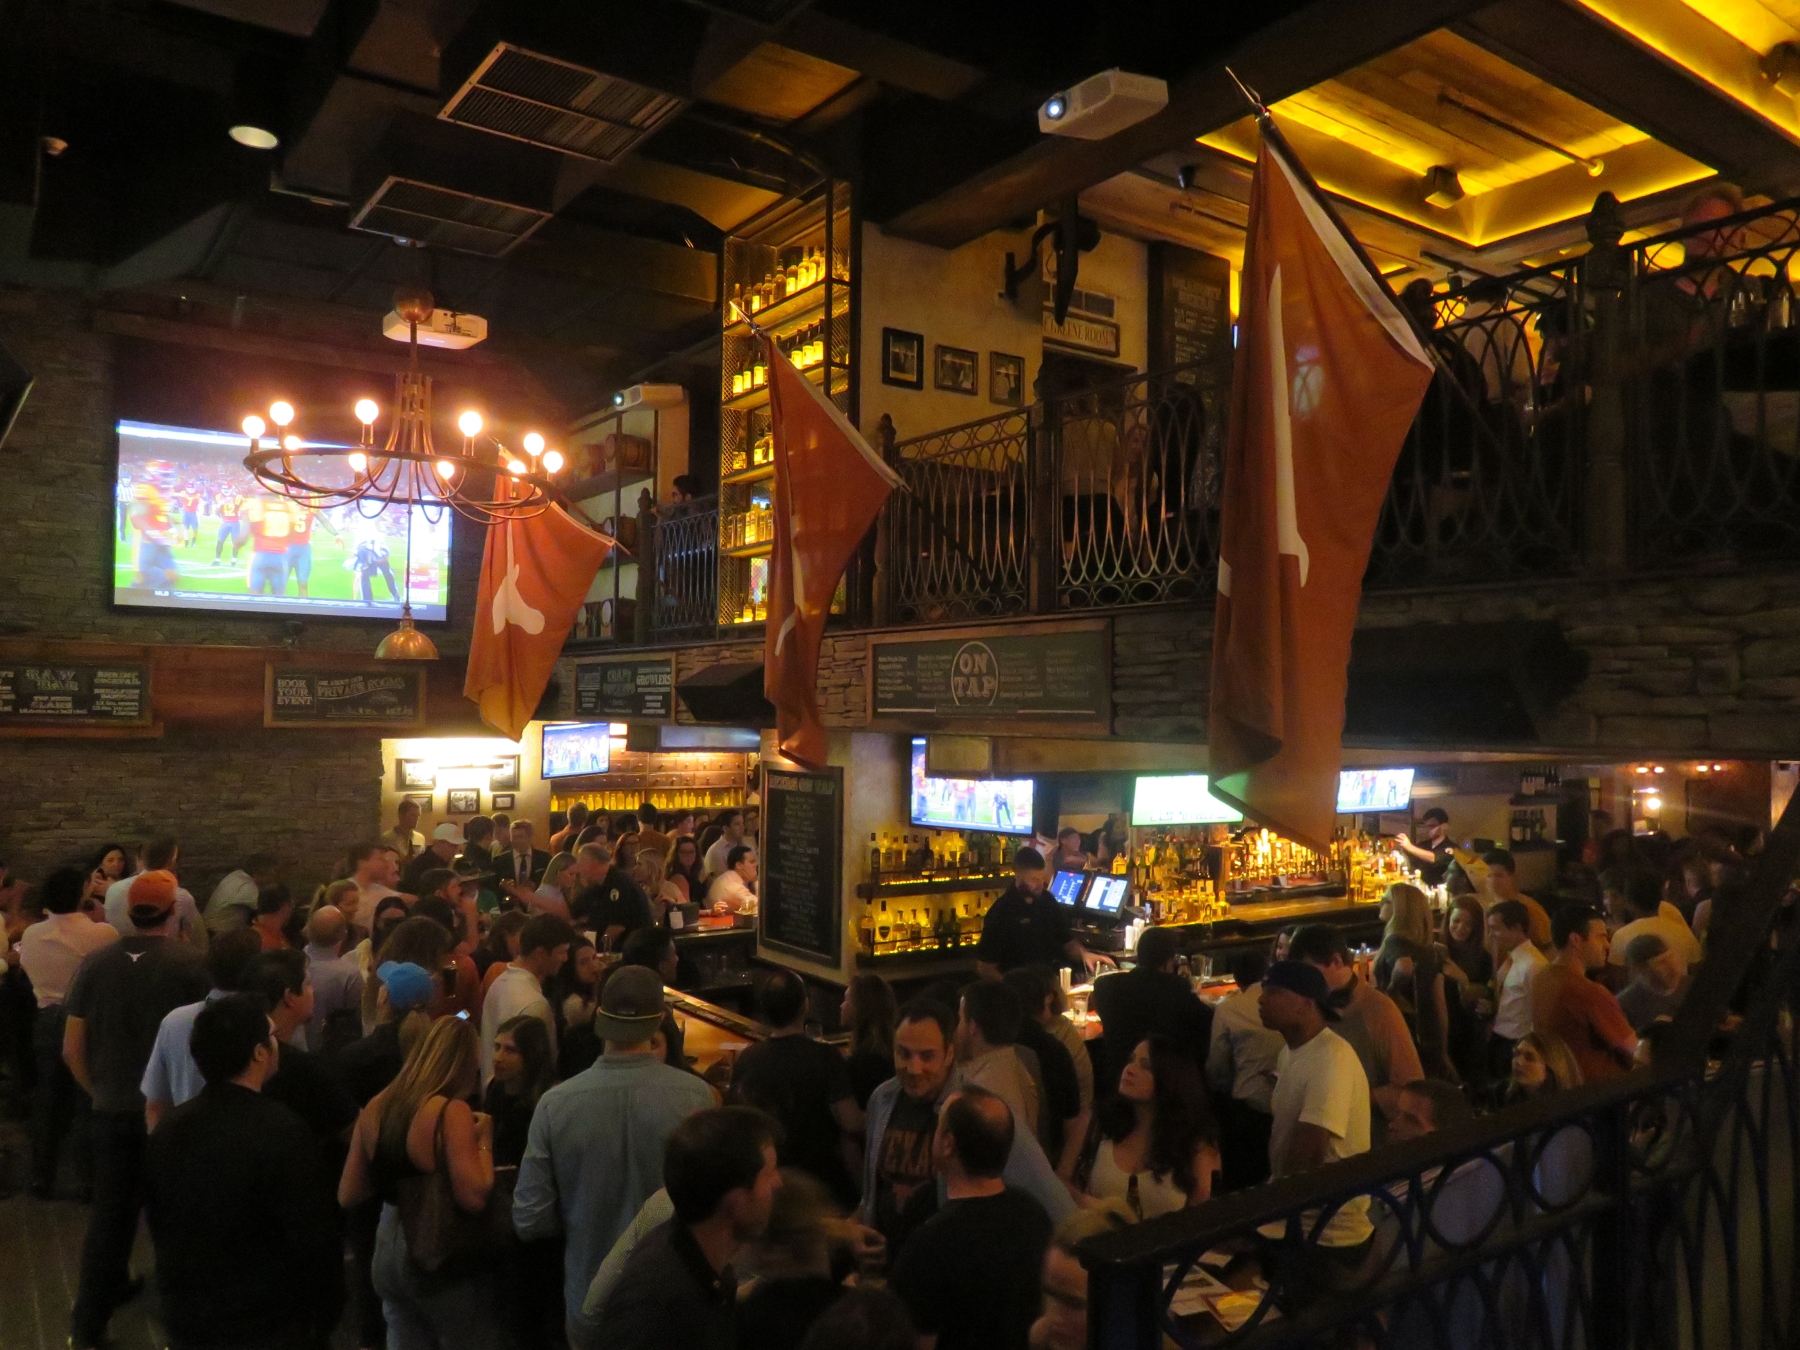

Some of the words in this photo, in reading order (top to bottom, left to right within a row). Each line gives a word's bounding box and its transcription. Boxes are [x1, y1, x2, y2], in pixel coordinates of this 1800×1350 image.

[960, 653, 989, 674] ON
[26, 669, 76, 681] RAW
[636, 674, 671, 685] GROWLERS
[37, 681, 79, 691] BAR
[276, 679, 306, 687] BOOK
[317, 683, 366, 697] PRIVATE
[367, 677, 405, 691] ROOMS
[954, 676, 995, 697] TAP
[278, 687, 308, 697] YOUR
[276, 696, 313, 705] EVENT
